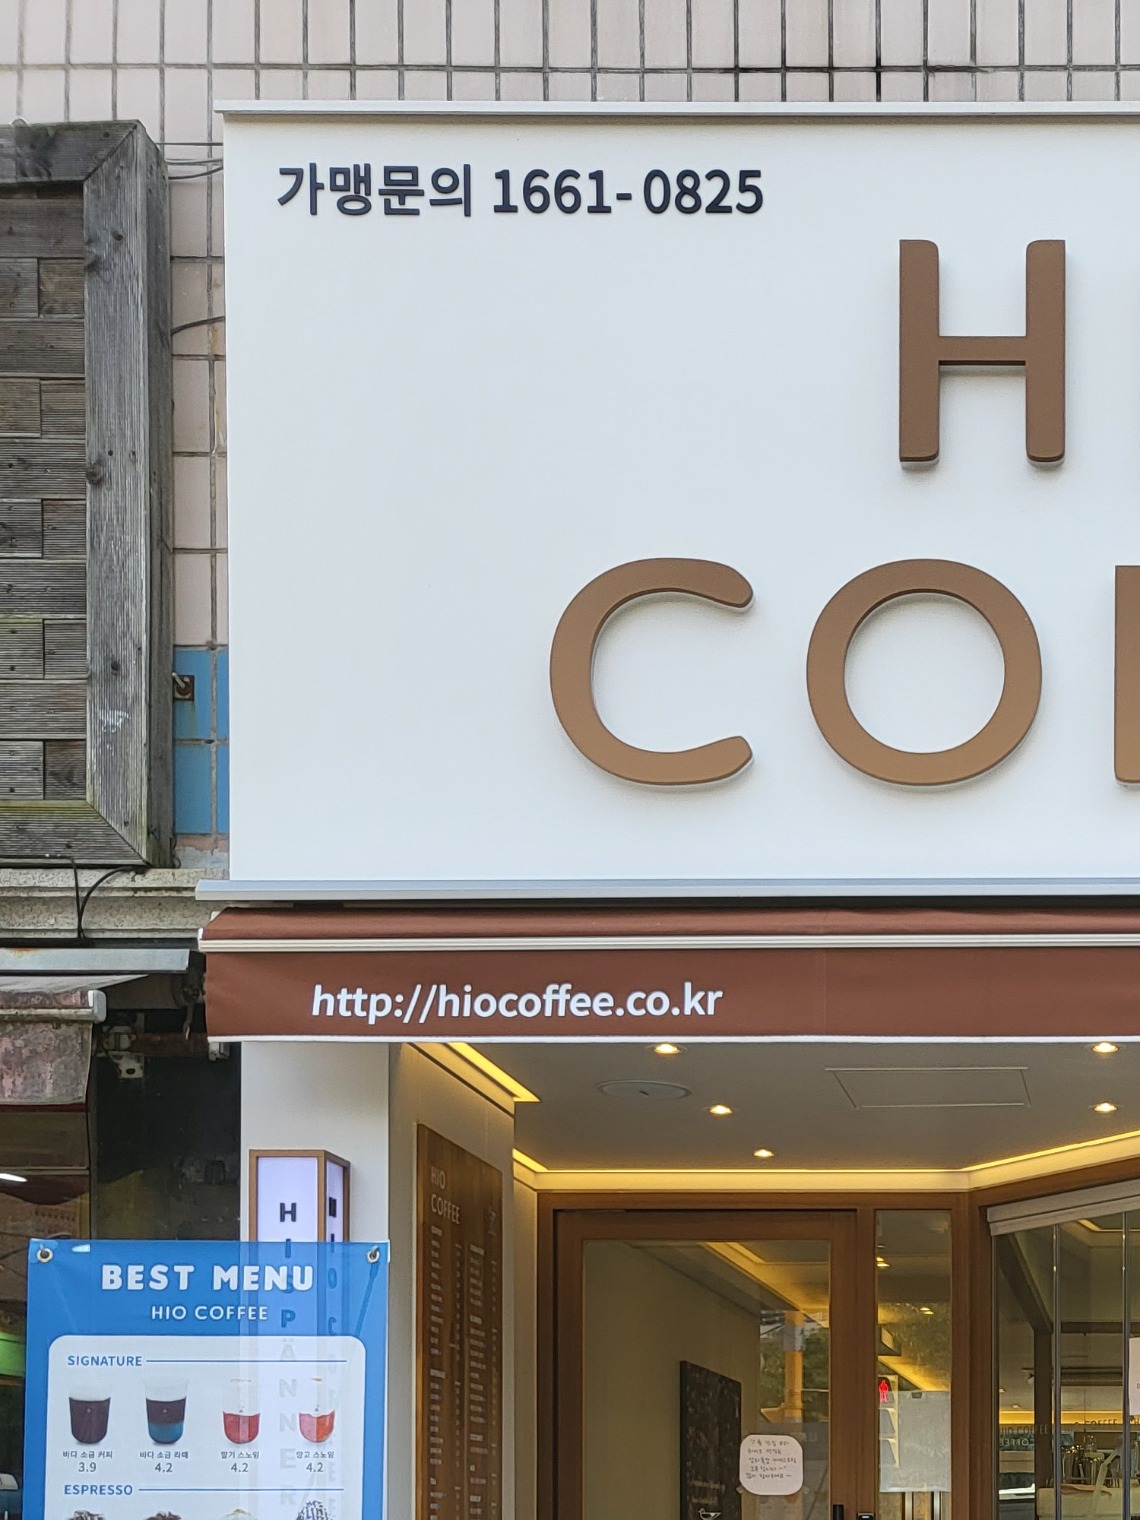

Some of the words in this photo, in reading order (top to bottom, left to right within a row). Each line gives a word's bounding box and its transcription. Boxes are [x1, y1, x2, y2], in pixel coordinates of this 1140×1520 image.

[276, 163, 472, 216] 가맹문의
[492, 166, 764, 216] 1661-0825
[312, 982, 723, 1024] http://hiocoffee.co.kr
[101, 1265, 194, 1291] BEST
[213, 1265, 314, 1291] MENU
[151, 1305, 187, 1321] HIO
[195, 1305, 269, 1321] COFFEE
[67, 1355, 142, 1367] SIGNATURE
[78, 1462, 97, 1473] 3.9
[155, 1463, 173, 1473] 4.2
[231, 1463, 249, 1473] 4.2
[306, 1462, 324, 1472] 4.2
[64, 1484, 134, 1496] ESPRESSO
